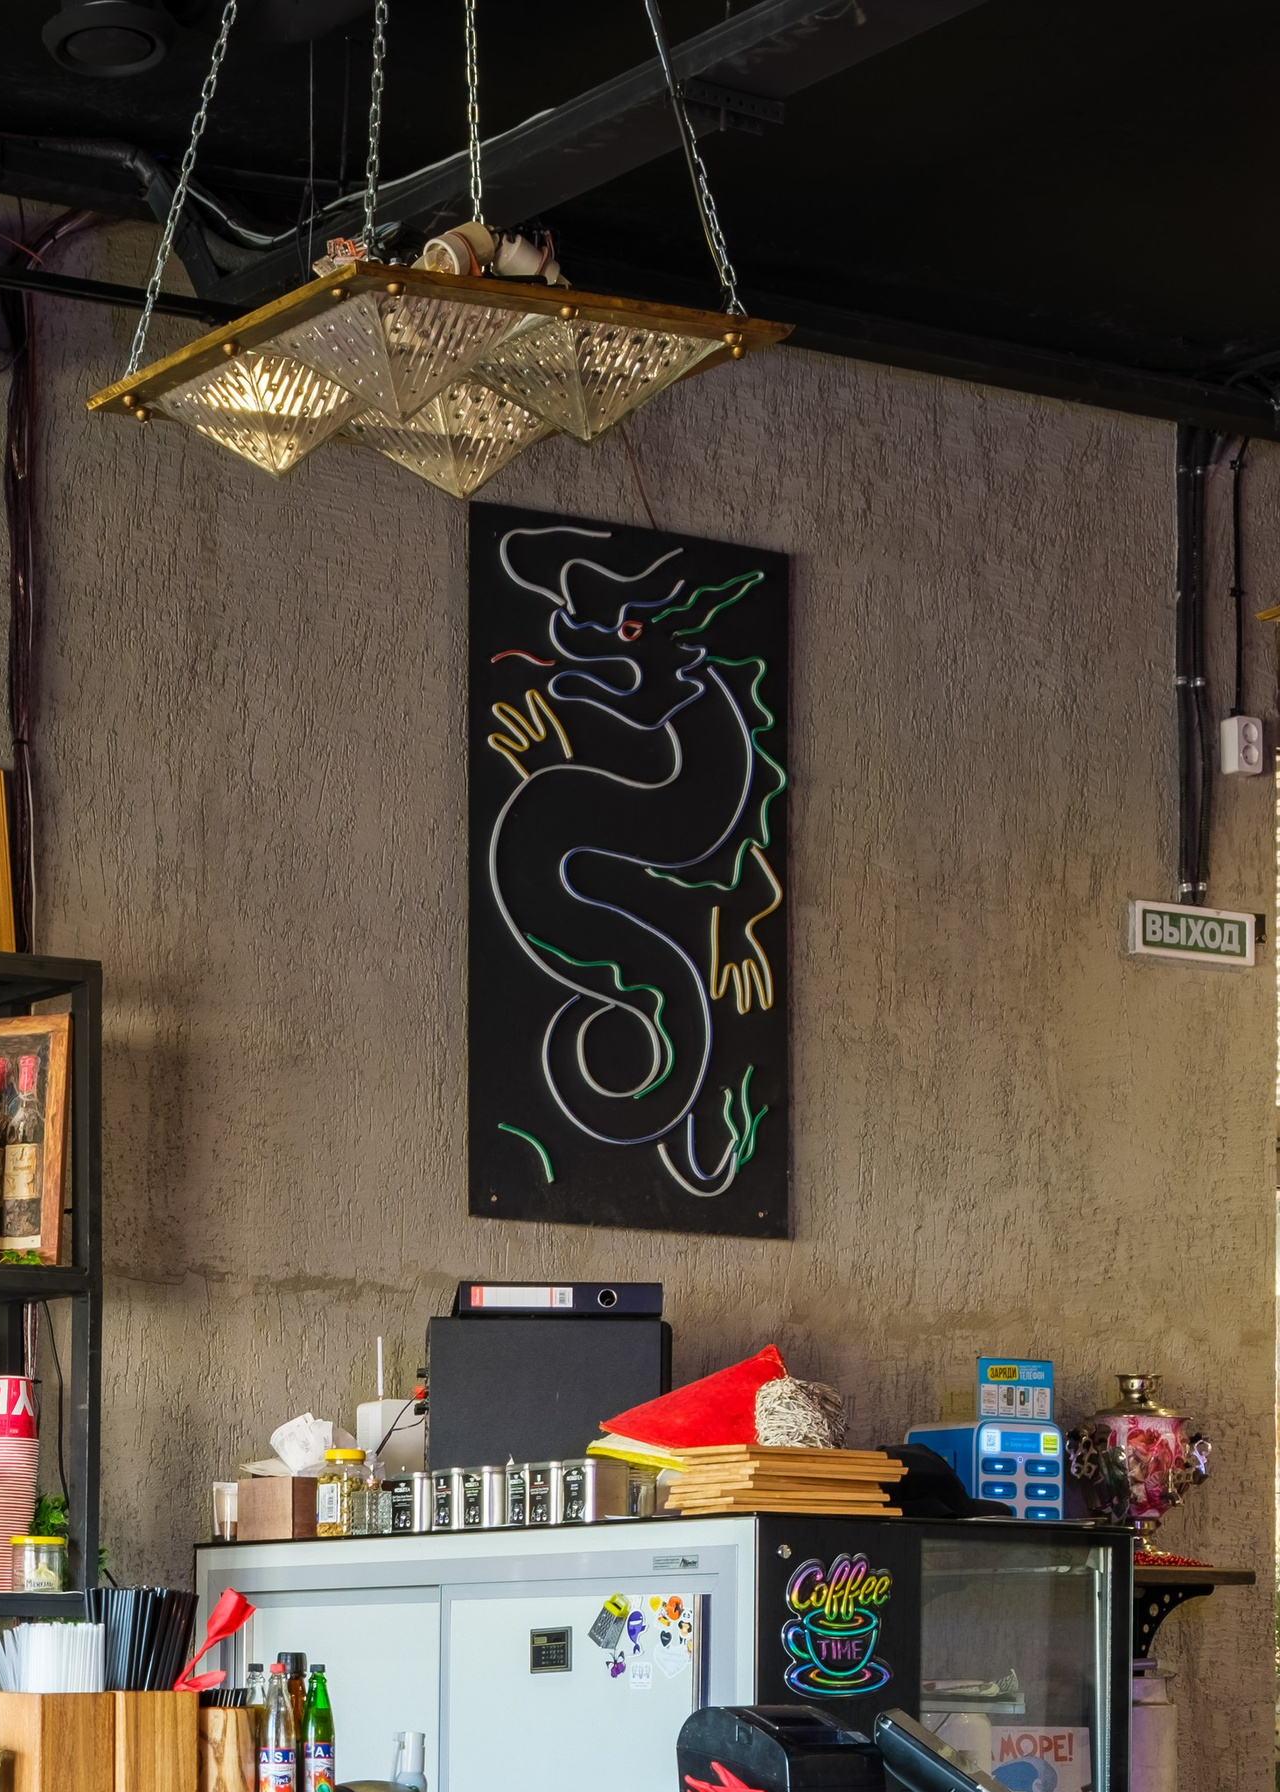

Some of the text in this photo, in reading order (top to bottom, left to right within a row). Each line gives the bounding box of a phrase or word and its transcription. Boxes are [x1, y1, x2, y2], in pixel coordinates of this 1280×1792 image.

[1146, 913, 1240, 953] ВЫХОД
[990, 1367, 1017, 1379] ЗАРЯДИ
[1020, 1371, 1045, 1380] ТЕЛЕФОН
[791, 1560, 891, 1621] Coffee
[816, 1640, 864, 1660] TIME
[1000, 1731, 1074, 1763] МОРЕ!
